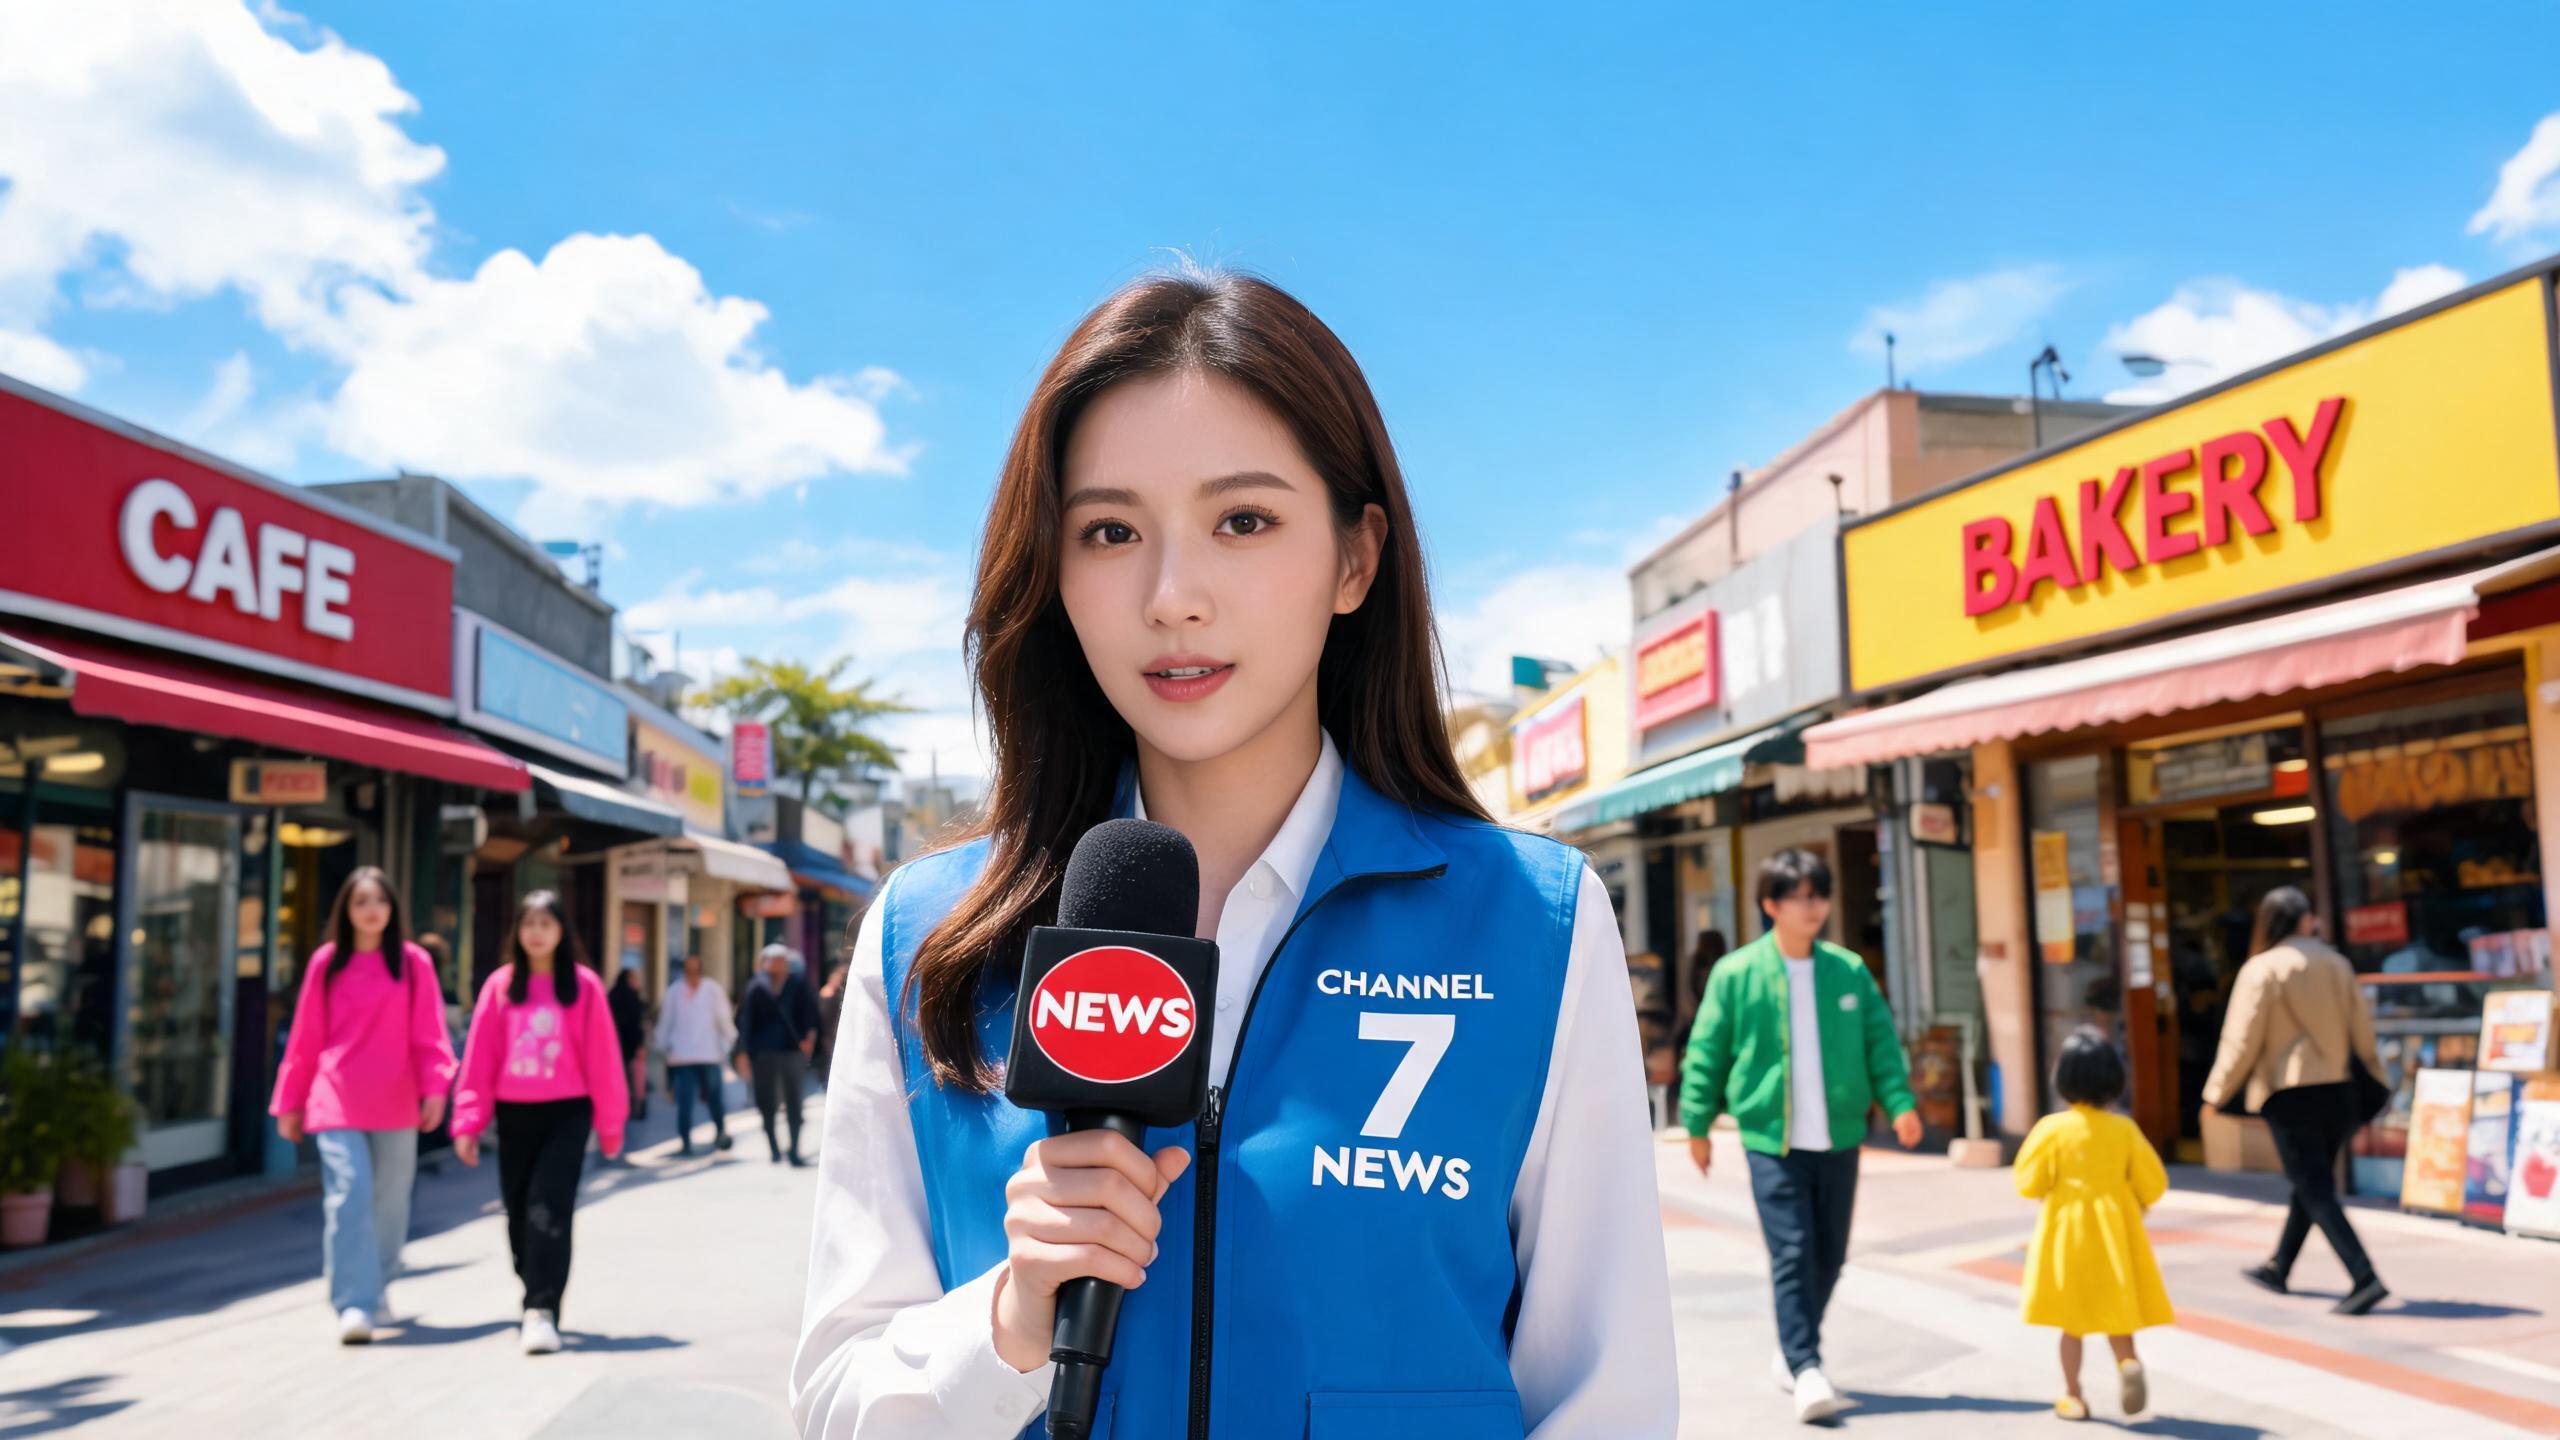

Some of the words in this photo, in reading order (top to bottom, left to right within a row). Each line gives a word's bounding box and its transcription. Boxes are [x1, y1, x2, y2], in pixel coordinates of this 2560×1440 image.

[1963, 397, 2348, 619] BAKERY
[121, 479, 356, 641] CAFE
[1036, 988, 1191, 1039] NEWS
[1317, 969, 1495, 1000] CHANNEL
[1358, 1011, 1456, 1139] 7
[1312, 1145, 1471, 1200] NEWS
